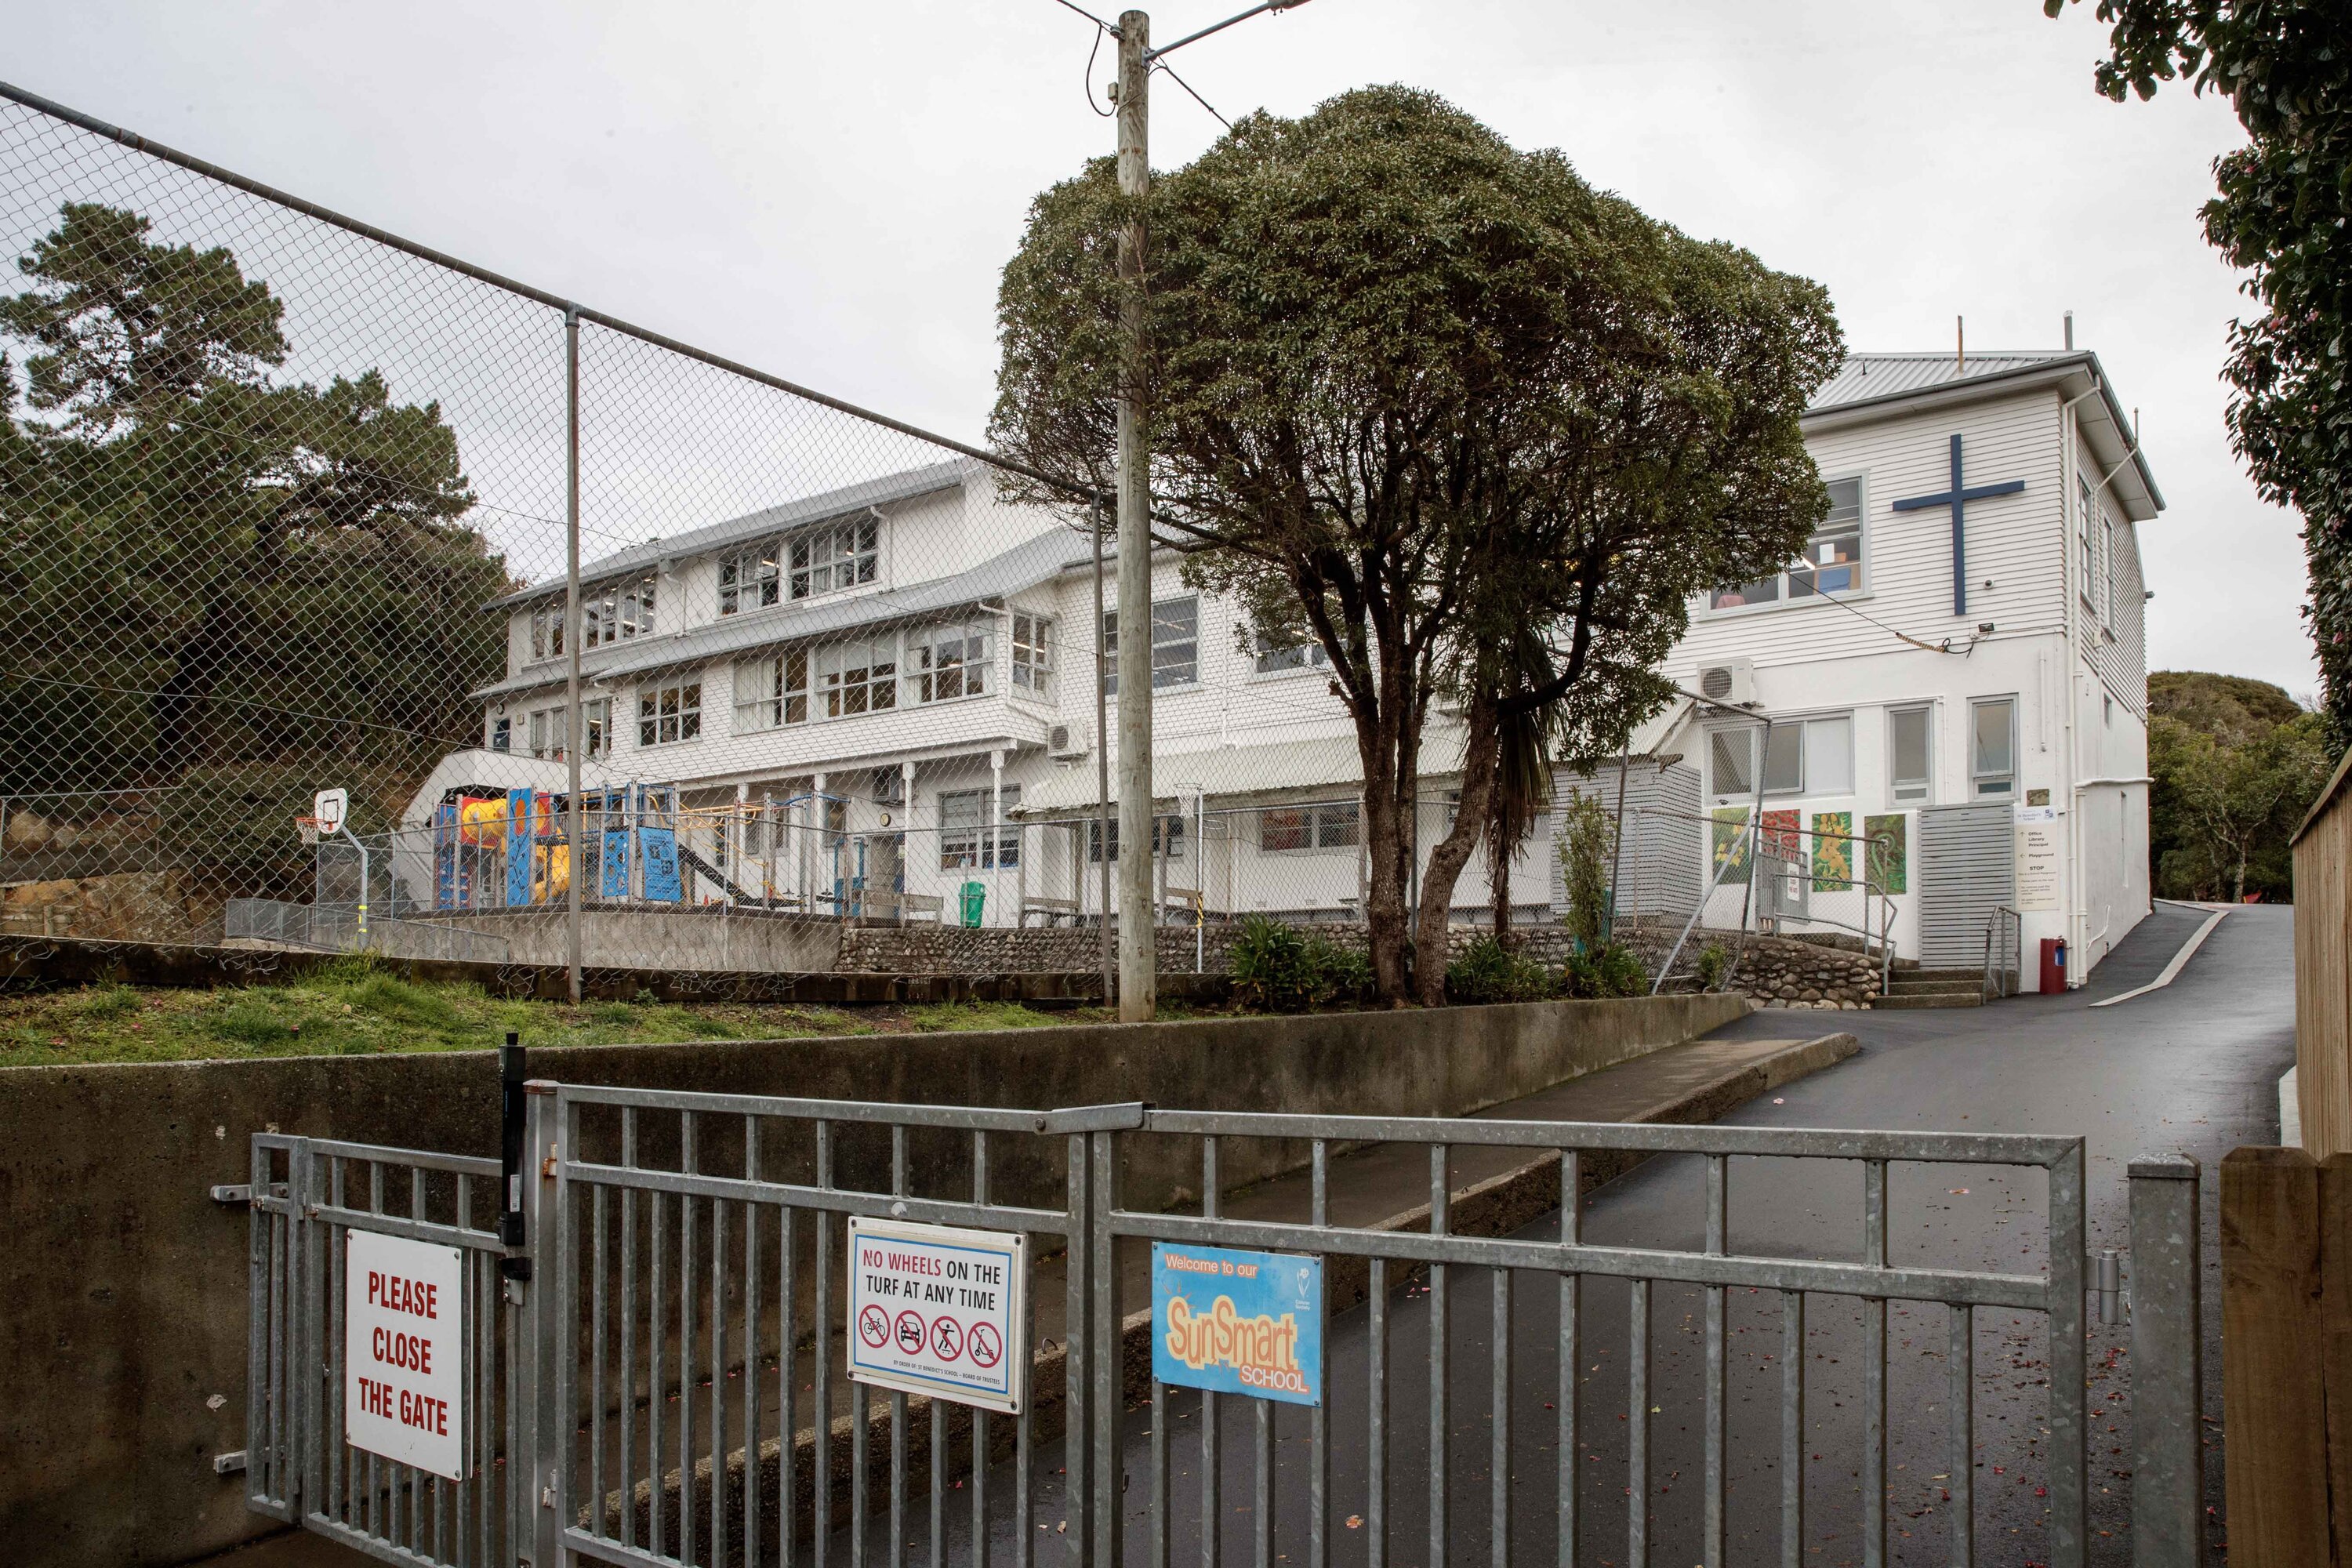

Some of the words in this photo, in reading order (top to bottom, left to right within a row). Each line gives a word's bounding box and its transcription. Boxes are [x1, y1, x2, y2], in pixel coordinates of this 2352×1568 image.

[863, 1249, 883, 1268] NO
[888, 1252, 941, 1276] WHEELS
[947, 1261, 968, 1280] ON
[974, 1264, 1000, 1285] THE
[1166, 1255, 1218, 1272] Welcome
[1222, 1261, 1233, 1274] to
[1238, 1265, 1257, 1276] our
[368, 1271, 437, 1319] PLEASE
[866, 1275, 899, 1296] TURF
[904, 1280, 920, 1299] AT
[924, 1283, 954, 1304] ANY
[959, 1288, 995, 1311] TIME
[373, 1327, 431, 1375] CLOSE
[1169, 1298, 1294, 1369] SunSmart
[1241, 1365, 1307, 1392] SCHOOL
[359, 1377, 393, 1419] THE
[400, 1389, 448, 1437] GATE
